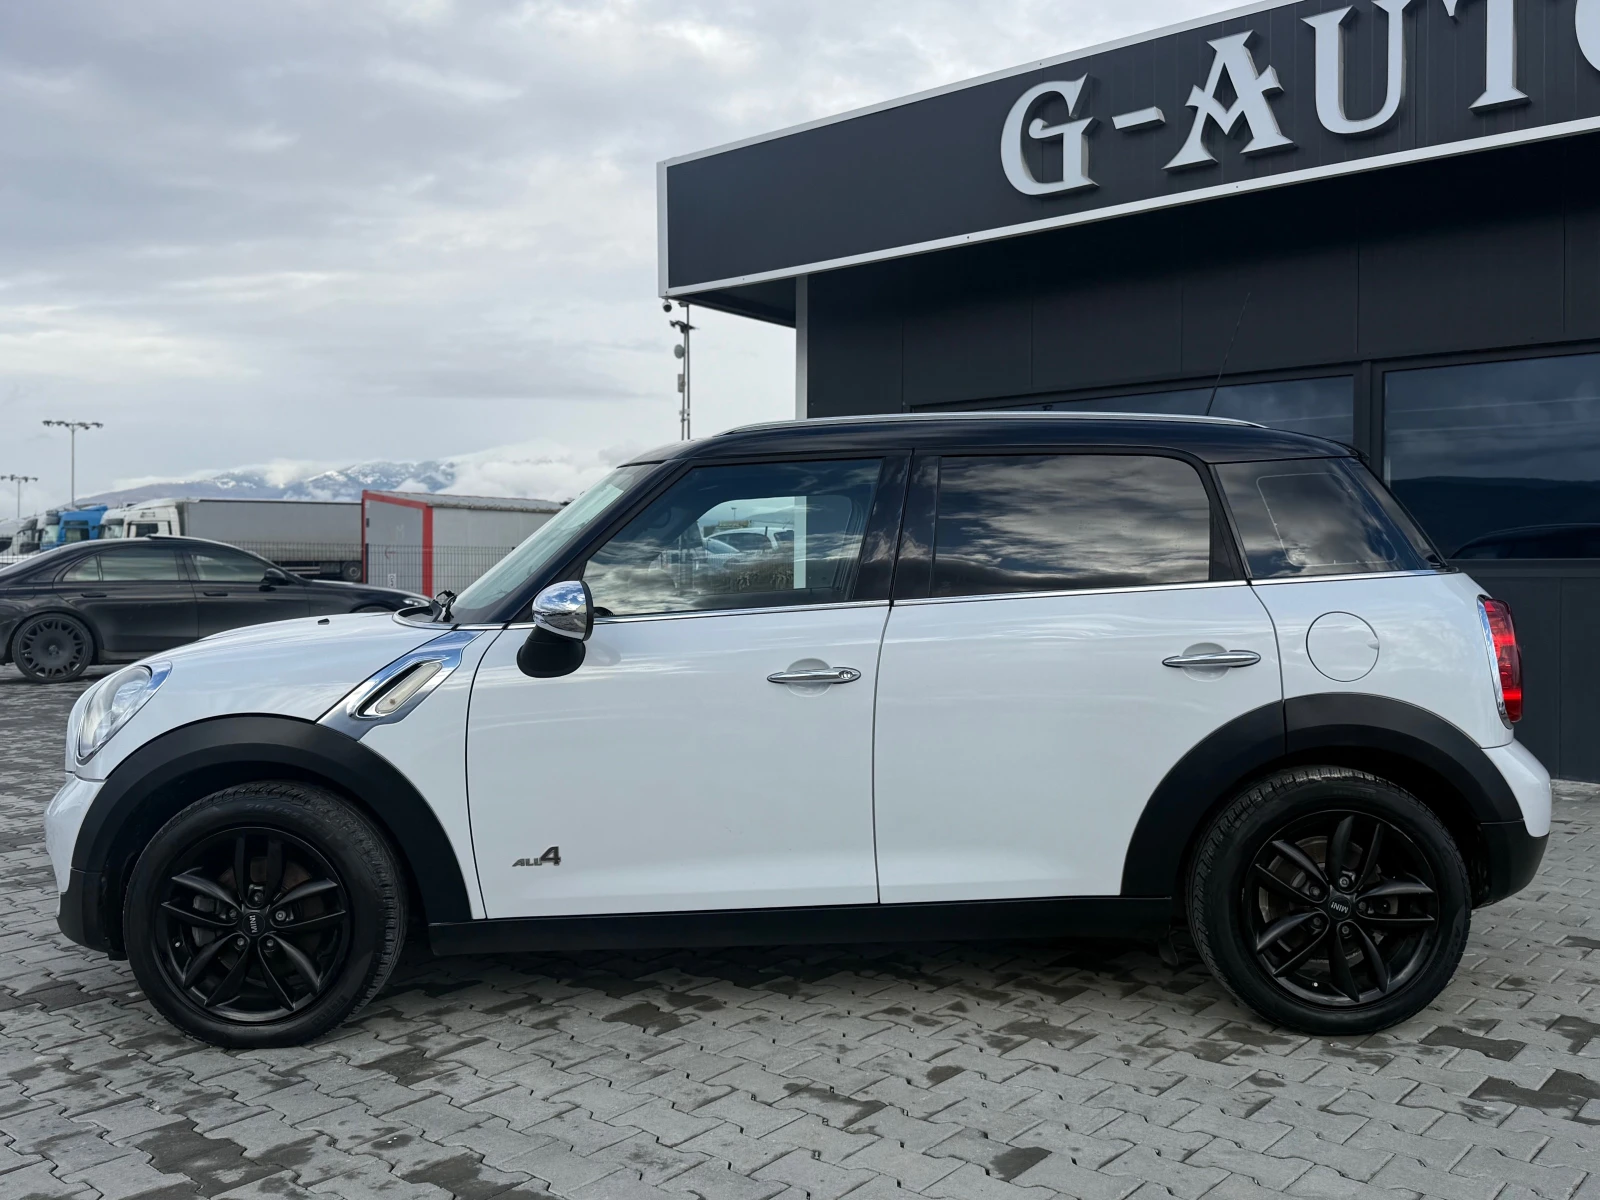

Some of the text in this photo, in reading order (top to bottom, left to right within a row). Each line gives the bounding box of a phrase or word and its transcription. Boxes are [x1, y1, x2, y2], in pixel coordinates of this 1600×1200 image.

[1000, 0, 1600, 197] G-AUT
[511, 846, 561, 867] ALL4
[1330, 901, 1349, 914] MINI
[249, 914, 258, 933] MINI
